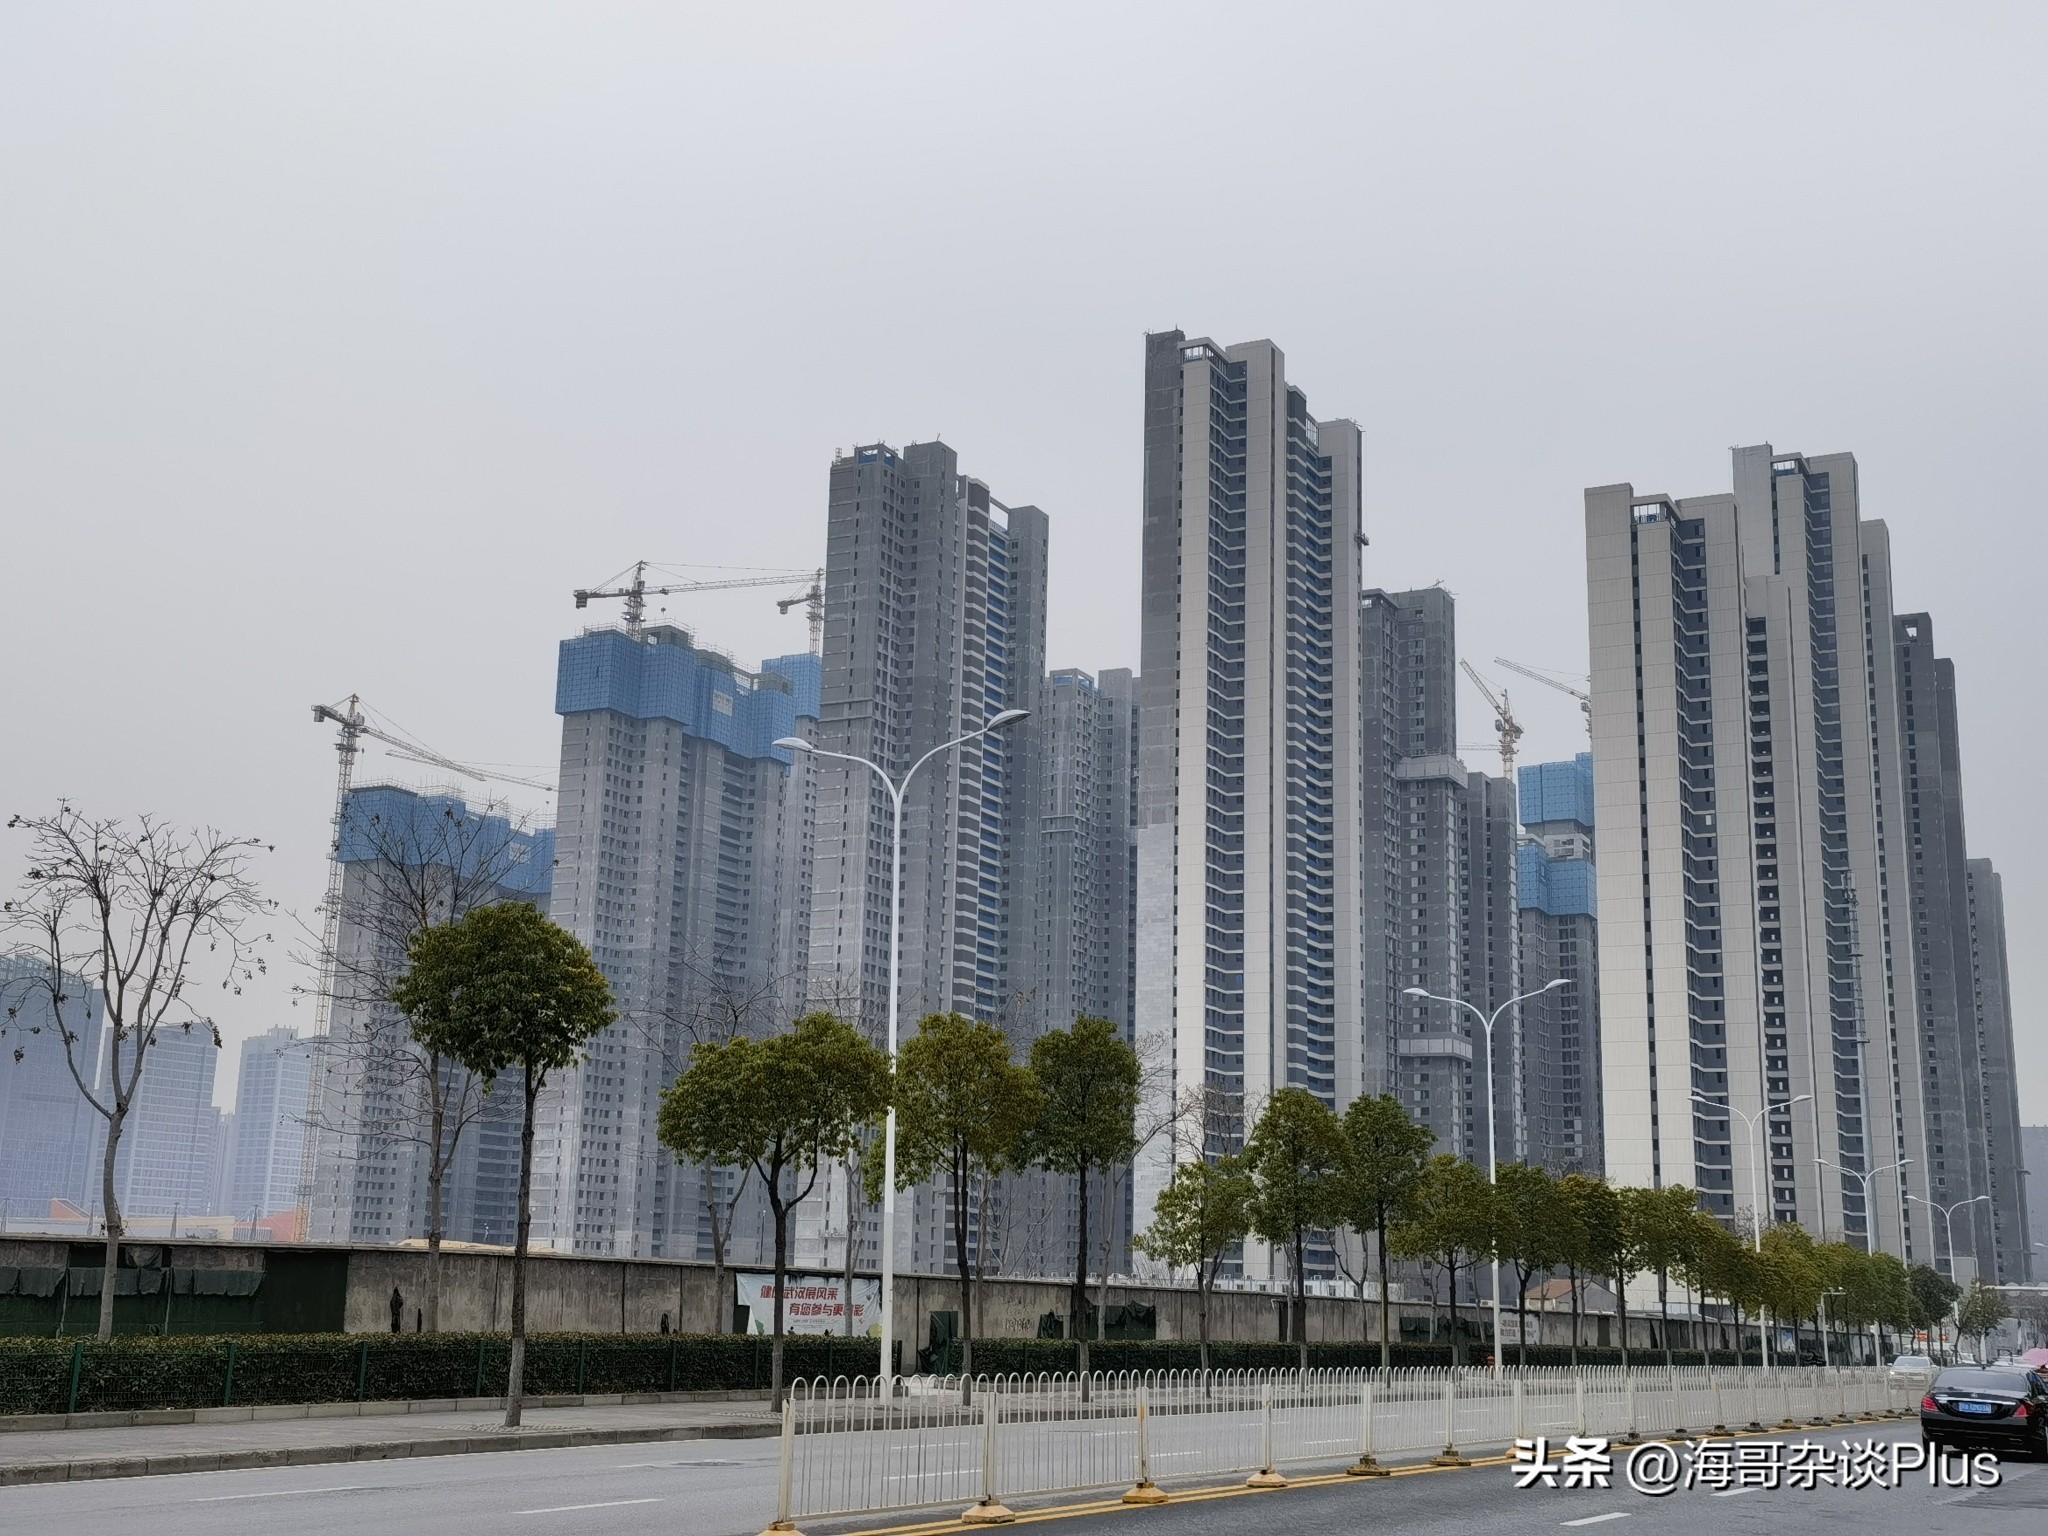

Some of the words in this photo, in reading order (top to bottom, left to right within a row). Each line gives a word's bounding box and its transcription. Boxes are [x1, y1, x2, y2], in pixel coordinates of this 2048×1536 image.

[760, 1285, 838, 1300] 健武汉展风采
[789, 1303, 865, 1316] 有您参与更彩
